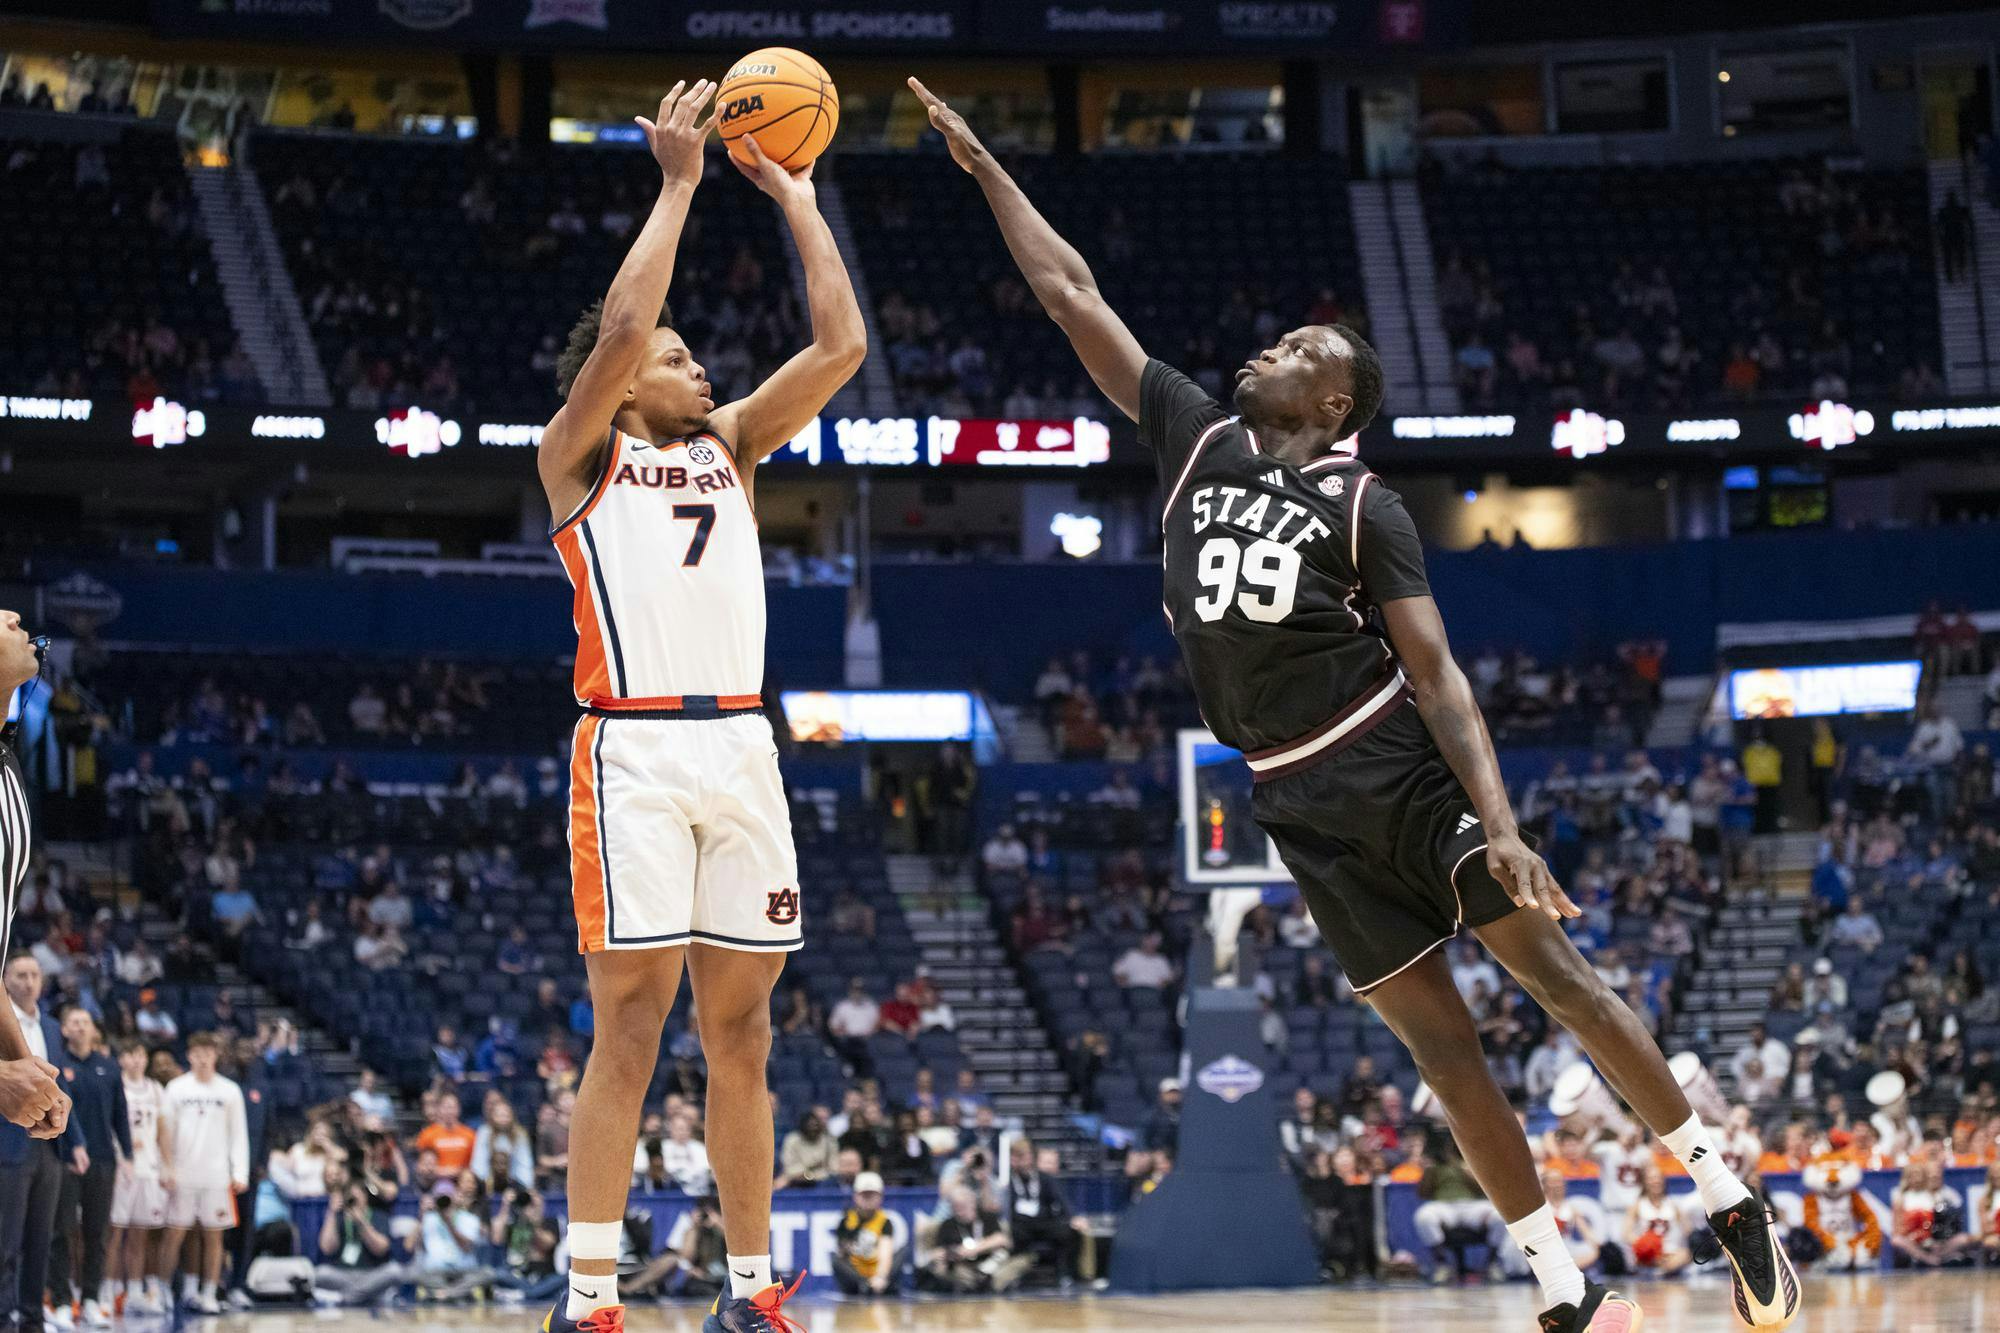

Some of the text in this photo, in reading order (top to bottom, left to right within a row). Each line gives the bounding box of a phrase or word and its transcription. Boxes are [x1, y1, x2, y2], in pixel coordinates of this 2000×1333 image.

[687, 13, 953, 38] OFFICIAL SPONSORS
[614, 463, 736, 495] AUBRN
[672, 503, 716, 567] 7
[1195, 537, 1302, 623] 99
